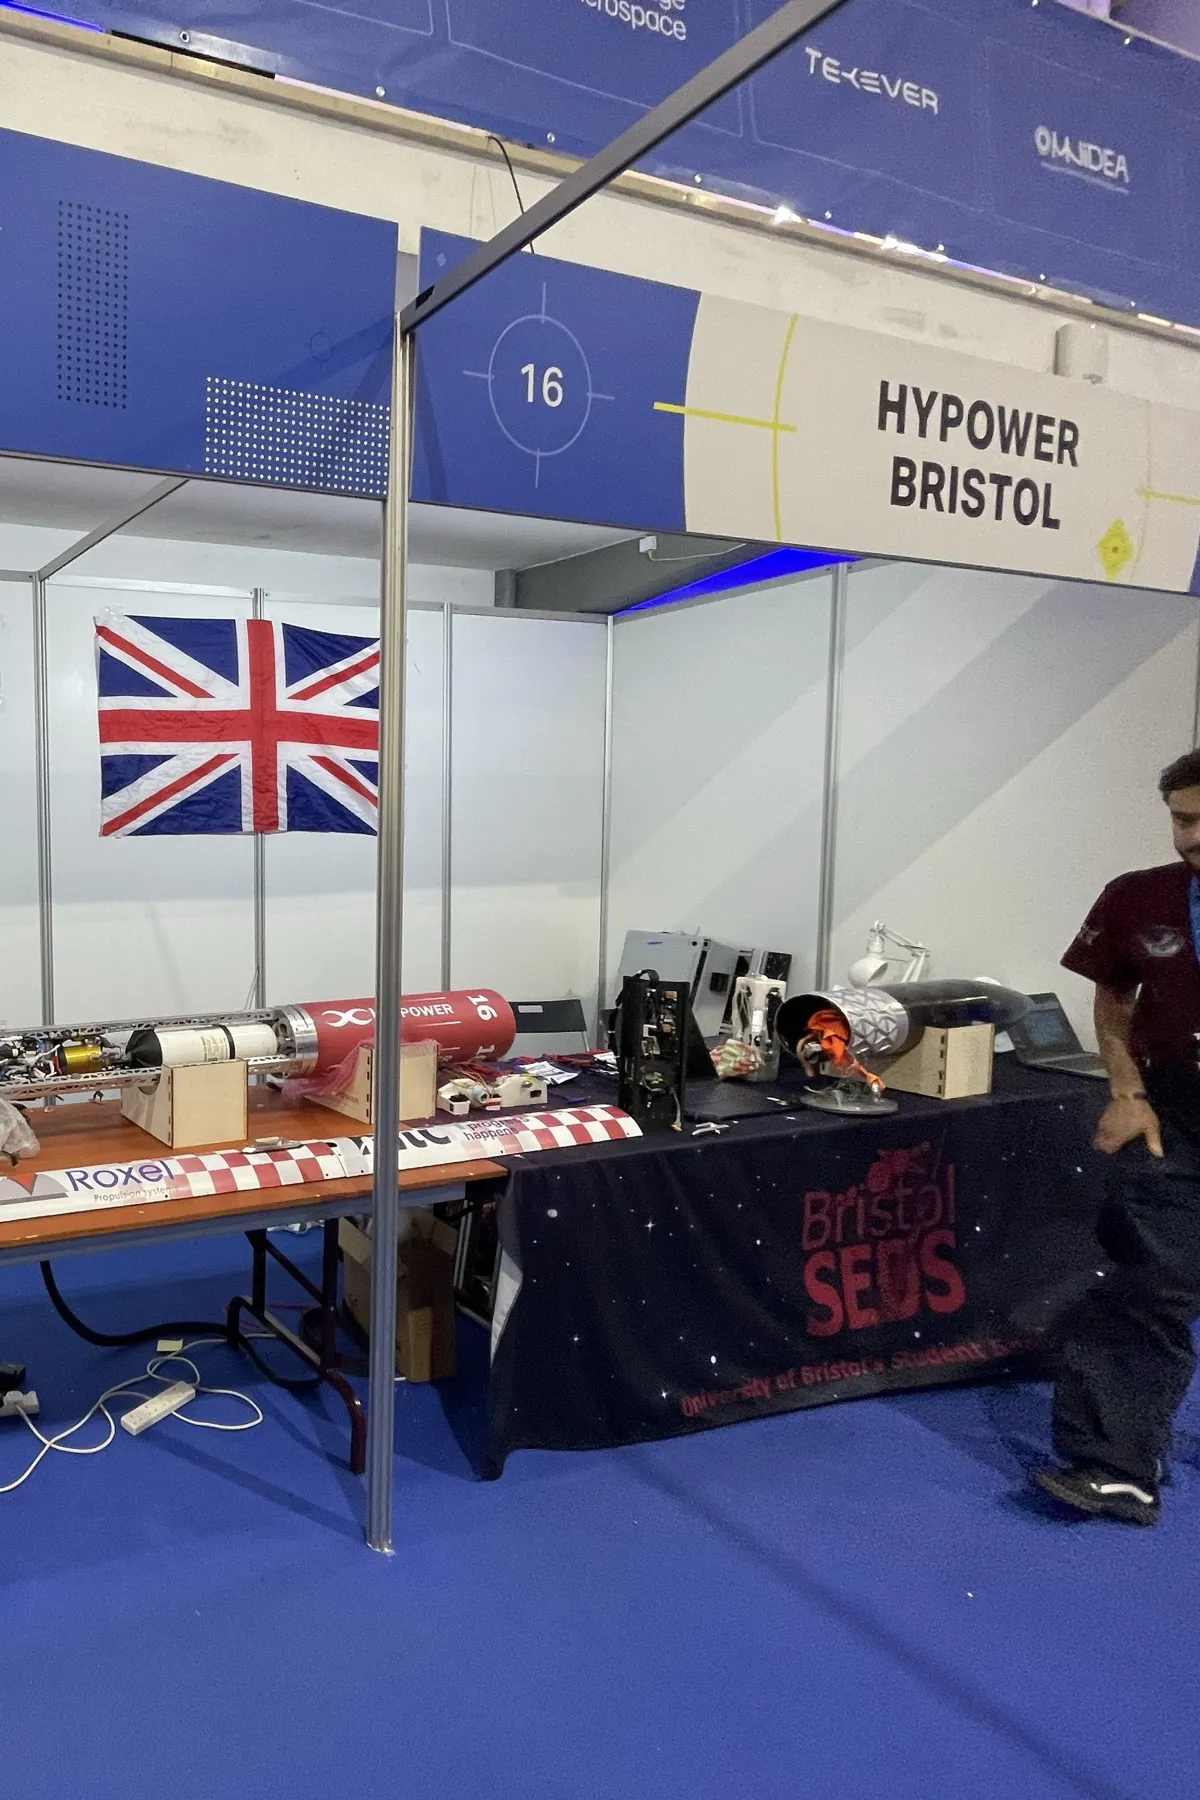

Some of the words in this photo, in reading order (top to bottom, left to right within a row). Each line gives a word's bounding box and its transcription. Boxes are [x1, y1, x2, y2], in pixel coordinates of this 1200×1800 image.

[520, 363, 564, 408] 16
[877, 379, 1079, 467] HYPOWER
[889, 455, 1061, 530] BRISTOL
[368, 1003, 455, 1018] POWER
[467, 994, 498, 1021] 16
[463, 1127, 520, 1141] happens
[65, 1159, 175, 1192] Roxel
[93, 1189, 141, 1202] Propulsion
[802, 1164, 956, 1250] Bristol
[803, 1228, 966, 1336] SEDS
